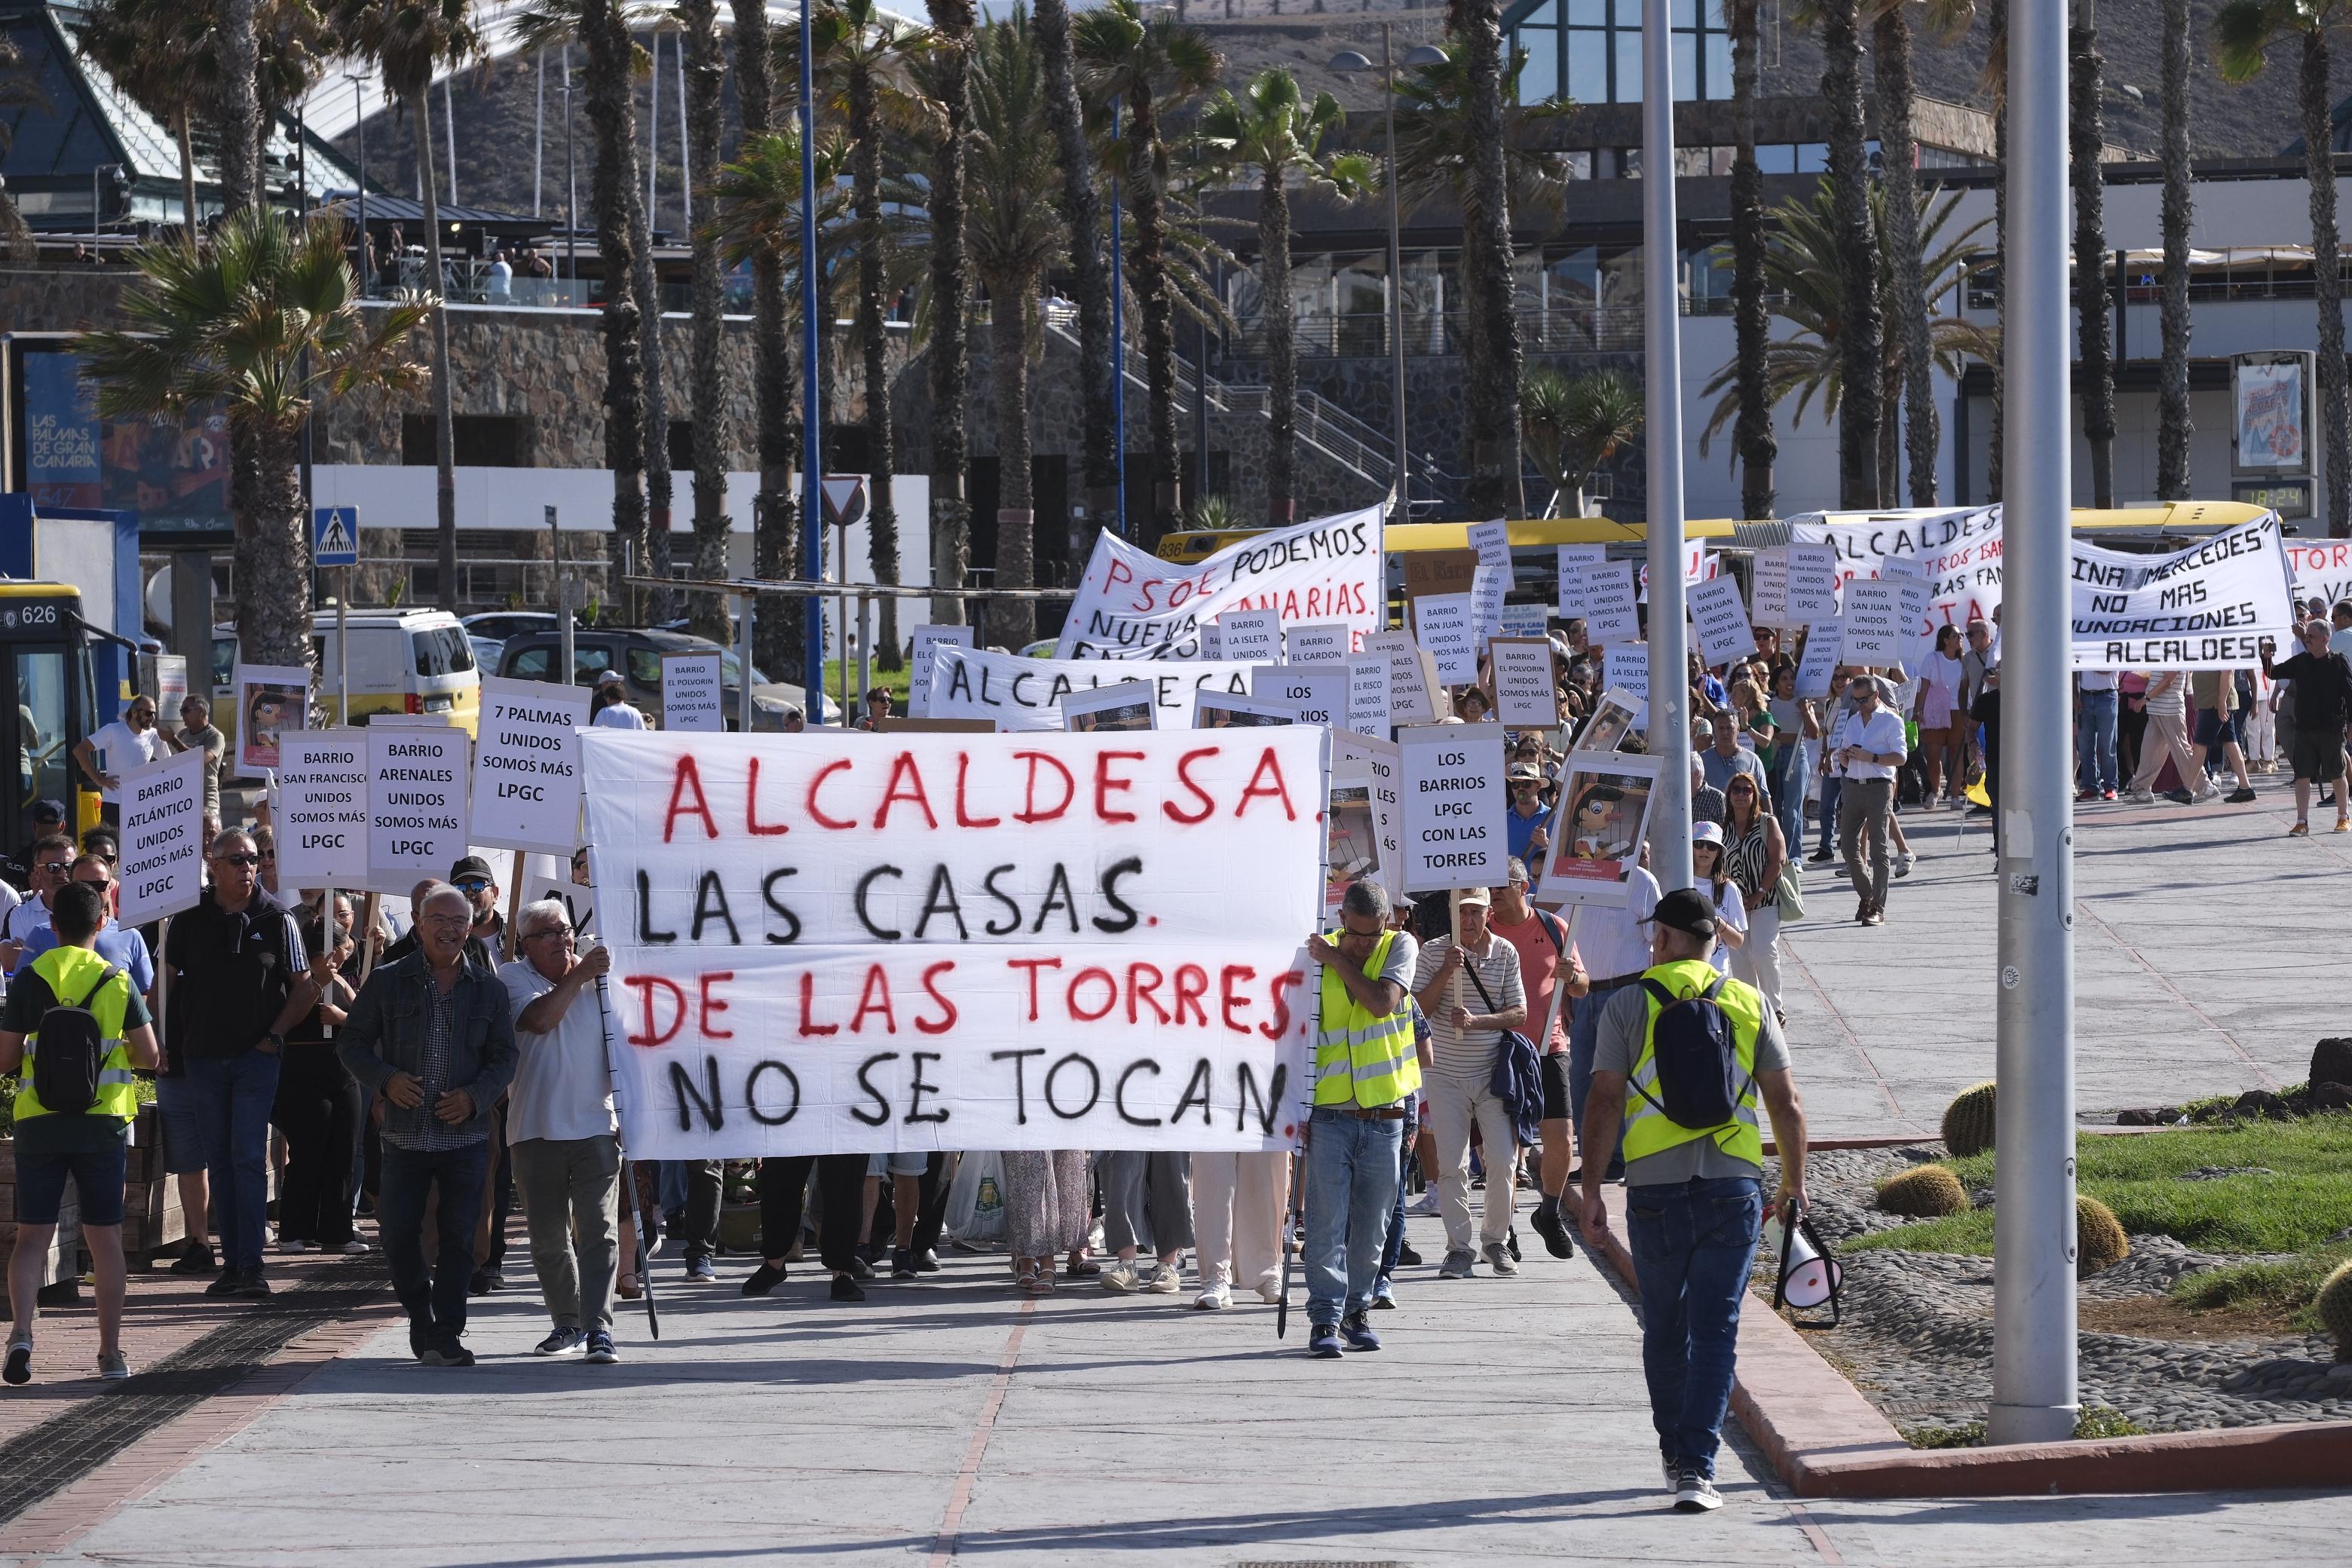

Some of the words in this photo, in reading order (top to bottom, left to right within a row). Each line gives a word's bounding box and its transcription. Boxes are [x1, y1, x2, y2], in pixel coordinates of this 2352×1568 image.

[32, 415, 56, 427] LAS
[32, 428, 89, 441] PALMAS
[33, 441, 49, 454] DE
[54, 441, 95, 454] GRAN
[33, 455, 96, 467] CANARIA
[2250, 490, 2298, 507] 18:24
[1477, 528, 1497, 537] BARRIO
[1484, 538, 1505, 547] TORRES
[1159, 542, 1182, 558] 836
[1479, 551, 1501, 559] UNIDOS
[2287, 545, 2352, 571] TOR
[1592, 571, 1620, 580] BARRIO
[1600, 582, 1629, 592] TORRES
[1697, 587, 1725, 600] BARRIO
[2092, 596, 2128, 613] NO
[2160, 579, 2207, 610] MAS
[1594, 596, 1623, 605] UNIDOS
[1697, 605, 1712, 614] SAN
[1714, 599, 1733, 609] JUAN
[22, 606, 56, 624] 626
[1427, 607, 1457, 617] BARRIO
[1588, 608, 1614, 617] SOMOS
[1704, 611, 1733, 625] UNIDOS
[2073, 602, 2256, 634] UNDACIONES
[1231, 620, 1264, 629] BARRIO
[1424, 622, 1441, 630] SAN
[1443, 620, 1463, 629] JUAN
[1598, 620, 1621, 629] LPGC
[1855, 616, 1887, 624] UNIDOS
[1089, 610, 1198, 647] NUEVA
[1701, 626, 1726, 639] SOMOS
[1728, 621, 1743, 631] MÁS
[1878, 628, 1894, 637] MÁS
[926, 636, 958, 646] BARRIO
[1243, 635, 1269, 644] ISLETA
[1300, 638, 1333, 646] BARRIO
[1429, 635, 1461, 644] UNIDOS
[1713, 637, 1735, 649] LPGC
[1233, 650, 1267, 659] UNIDOS
[1304, 651, 1341, 660] CARDON
[1453, 646, 1469, 654] MÁS
[1355, 666, 1381, 675] BARRIO
[1354, 682, 1361, 691] EL
[1366, 681, 1382, 690] RISCO
[1407, 683, 1423, 692] MÁS
[1286, 687, 1312, 699] LOS
[1532, 688, 1549, 697] MÁS
[1355, 696, 1381, 706] UNIDOS
[1392, 700, 1414, 710] LPGC
[495, 705, 503, 719] 7
[508, 706, 572, 727] PALMAS
[1349, 711, 1371, 719] SOMOS
[1373, 709, 1386, 718] MÁS
[499, 730, 562, 752] UNIDOS
[388, 744, 443, 758] BARRIO
[304, 752, 354, 764] BARRIO
[1438, 753, 1465, 766] LOS
[482, 755, 535, 773] SOMOS
[540, 758, 574, 777] MÁS
[283, 774, 306, 784] SAN
[310, 773, 367, 783] FRANCISC
[379, 768, 452, 782] ARENALES
[137, 776, 184, 804] BARRIO
[1419, 776, 1486, 792] BARRIOS
[305, 793, 352, 803] UNIDOS
[498, 782, 544, 803] LPGC
[388, 793, 445, 806] UNIDOS
[127, 796, 194, 830] ATLÁNTICO
[1435, 801, 1472, 816] LPGC
[290, 813, 335, 822] SOMOS
[339, 810, 366, 822] MÁS
[375, 816, 424, 828] SOMOS
[429, 816, 458, 828] MÁS
[136, 825, 184, 851] UNIDOS
[1423, 828, 1455, 842] CON
[1459, 825, 1486, 840] LAS
[302, 835, 345, 849] LPGC
[392, 841, 433, 855] LPGC
[124, 853, 167, 877] SOMOS
[168, 844, 194, 866] MÁS
[1423, 852, 1487, 868] TORRES
[139, 875, 174, 899] LPGC
[635, 862, 743, 945] LAS
[623, 970, 735, 1049] DE
[798, 958, 958, 1037] LAS
[669, 1055, 801, 1133] NO
[850, 1051, 950, 1127] SE
